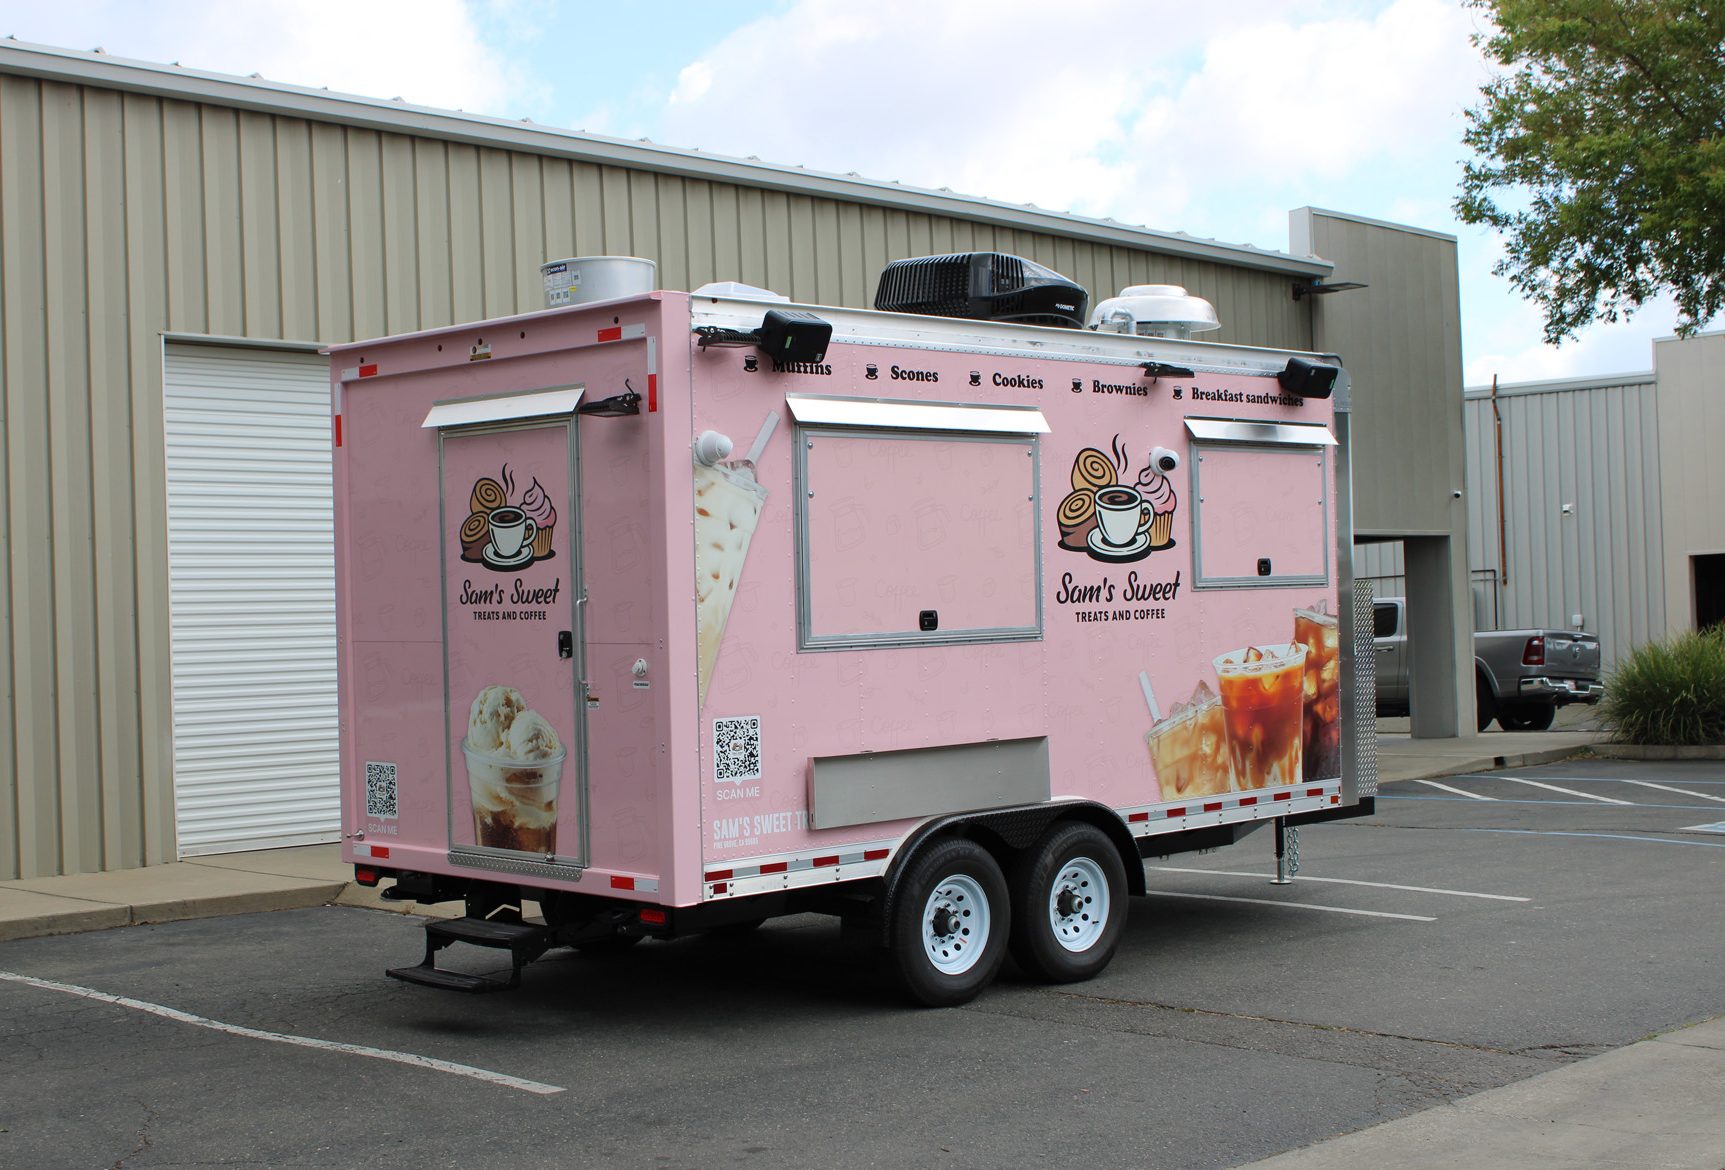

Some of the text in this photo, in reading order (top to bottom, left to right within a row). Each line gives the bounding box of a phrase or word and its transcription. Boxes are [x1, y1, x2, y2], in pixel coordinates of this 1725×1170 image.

[890, 365, 939, 383] Scones
[992, 372, 1044, 389] Cookies
[1092, 379, 1149, 397] Brownies
[1191, 387, 1304, 407] Breakfast sandwiches
[460, 577, 560, 605] Sam's Sweet
[1056, 570, 1180, 604] Sam's Sweet
[473, 610, 547, 620] TREATS AND COFFEE
[1075, 608, 1166, 623] TREATS AND COFFEE
[716, 786, 760, 800] SCAN ME
[368, 823, 398, 835] SCAN ME
[713, 816, 751, 840] SAM'S
[753, 811, 793, 835] SWEET
